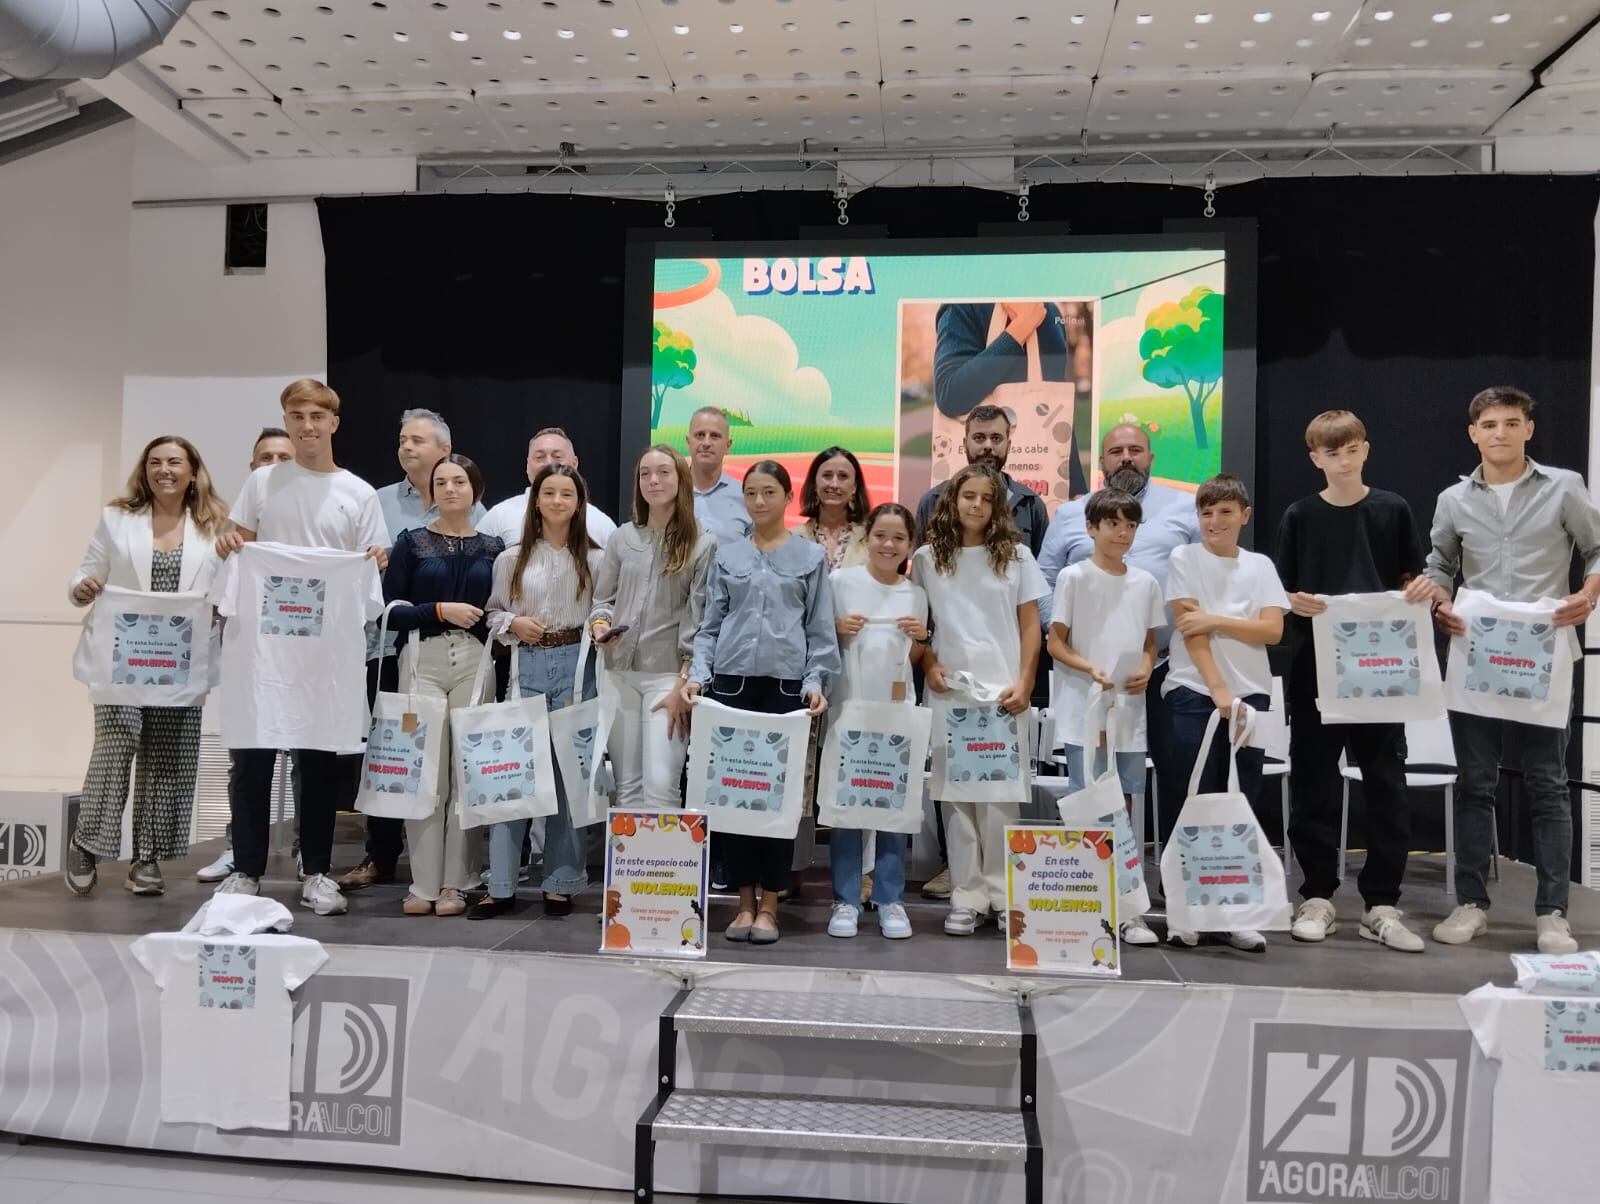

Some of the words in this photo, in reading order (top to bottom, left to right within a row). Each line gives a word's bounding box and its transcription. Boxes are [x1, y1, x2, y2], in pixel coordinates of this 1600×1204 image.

[743, 258, 875, 295] BOLSA
[1025, 444, 1048, 453] cabe
[1009, 463, 1040, 471] menos
[722, 777, 771, 792] VIOLENCIA
[615, 857, 625, 865] En
[627, 857, 644, 866] este
[646, 858, 677, 867] espacio
[679, 859, 698, 867] cabe
[1045, 856, 1057, 865] En
[1059, 857, 1080, 866] este
[615, 868, 625, 876] de
[626, 868, 645, 876] todo
[1032, 869, 1068, 879] espacio
[1070, 870, 1094, 879] cabe
[630, 881, 698, 896] VIOLENCIA
[1028, 882, 1039, 891] de
[1042, 882, 1063, 891] todo
[1065, 884, 1098, 892] menos
[1029, 898, 1101, 913] VIOLENCIA
